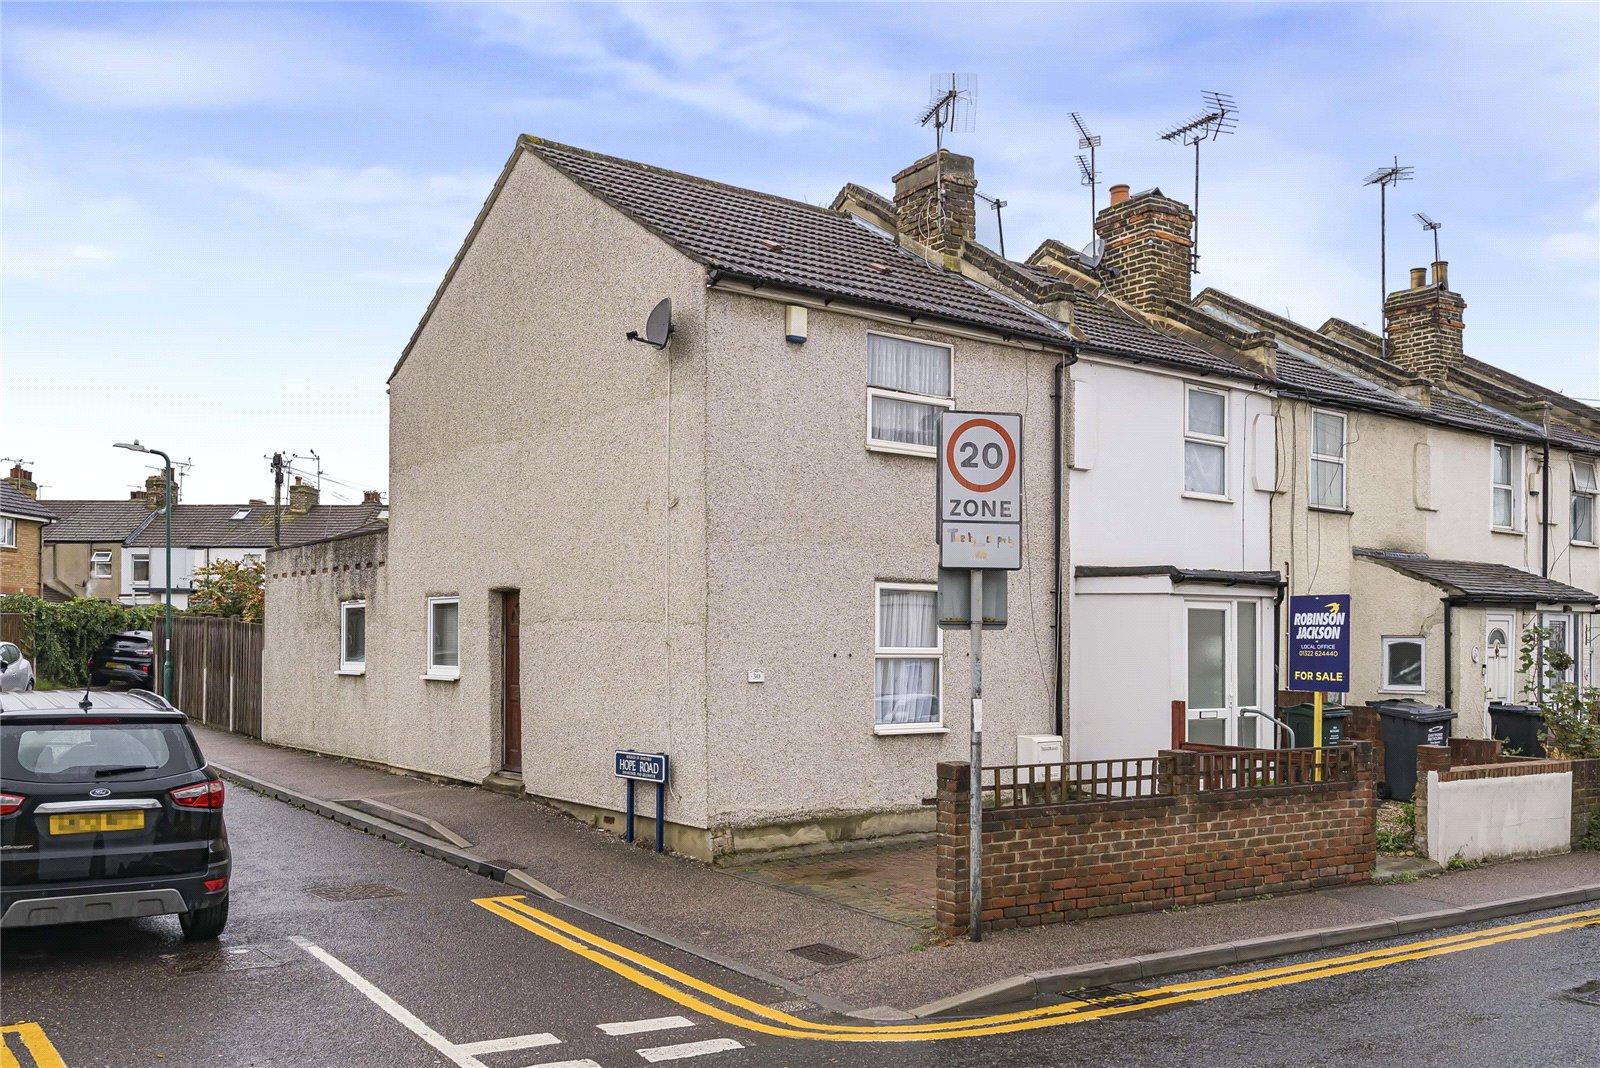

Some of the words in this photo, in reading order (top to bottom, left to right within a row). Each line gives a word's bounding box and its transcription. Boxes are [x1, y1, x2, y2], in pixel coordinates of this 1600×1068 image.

[960, 442, 1003, 469] 20
[950, 500, 1011, 518] ZONE
[1294, 612, 1346, 626] ROBINSON
[1296, 626, 1341, 640] JACKSON
[1294, 671, 1313, 681] FOR
[1315, 671, 1343, 682] SALE
[619, 759, 637, 772] HOPE
[639, 761, 660, 774] ROAD
